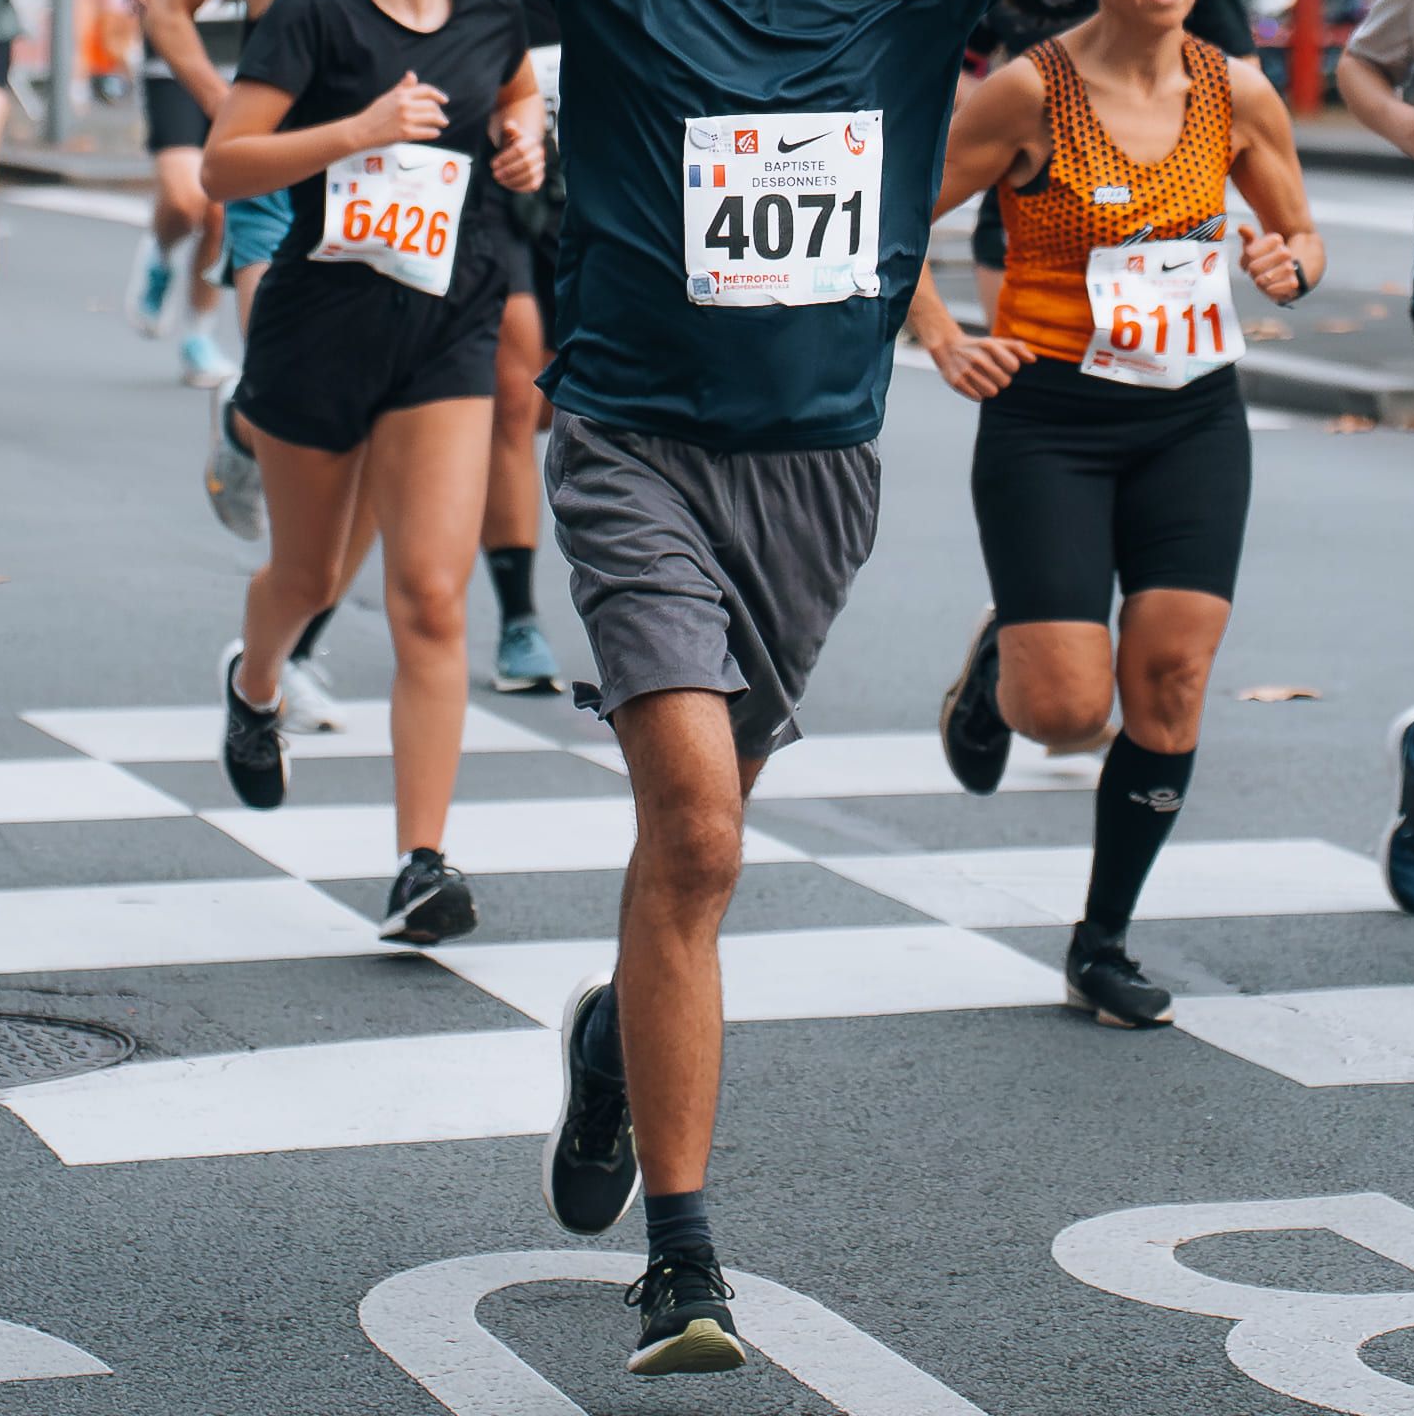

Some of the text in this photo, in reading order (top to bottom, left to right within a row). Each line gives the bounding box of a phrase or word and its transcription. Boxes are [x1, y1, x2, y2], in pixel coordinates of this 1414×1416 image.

[752, 175, 837, 188] DESBONNETS
[764, 160, 826, 172] BAPTISTE
[342, 199, 450, 258] 6426
[705, 190, 863, 261] 4071
[723, 272, 790, 284] MÉTROPOLE
[1110, 302, 1224, 356] 6111
